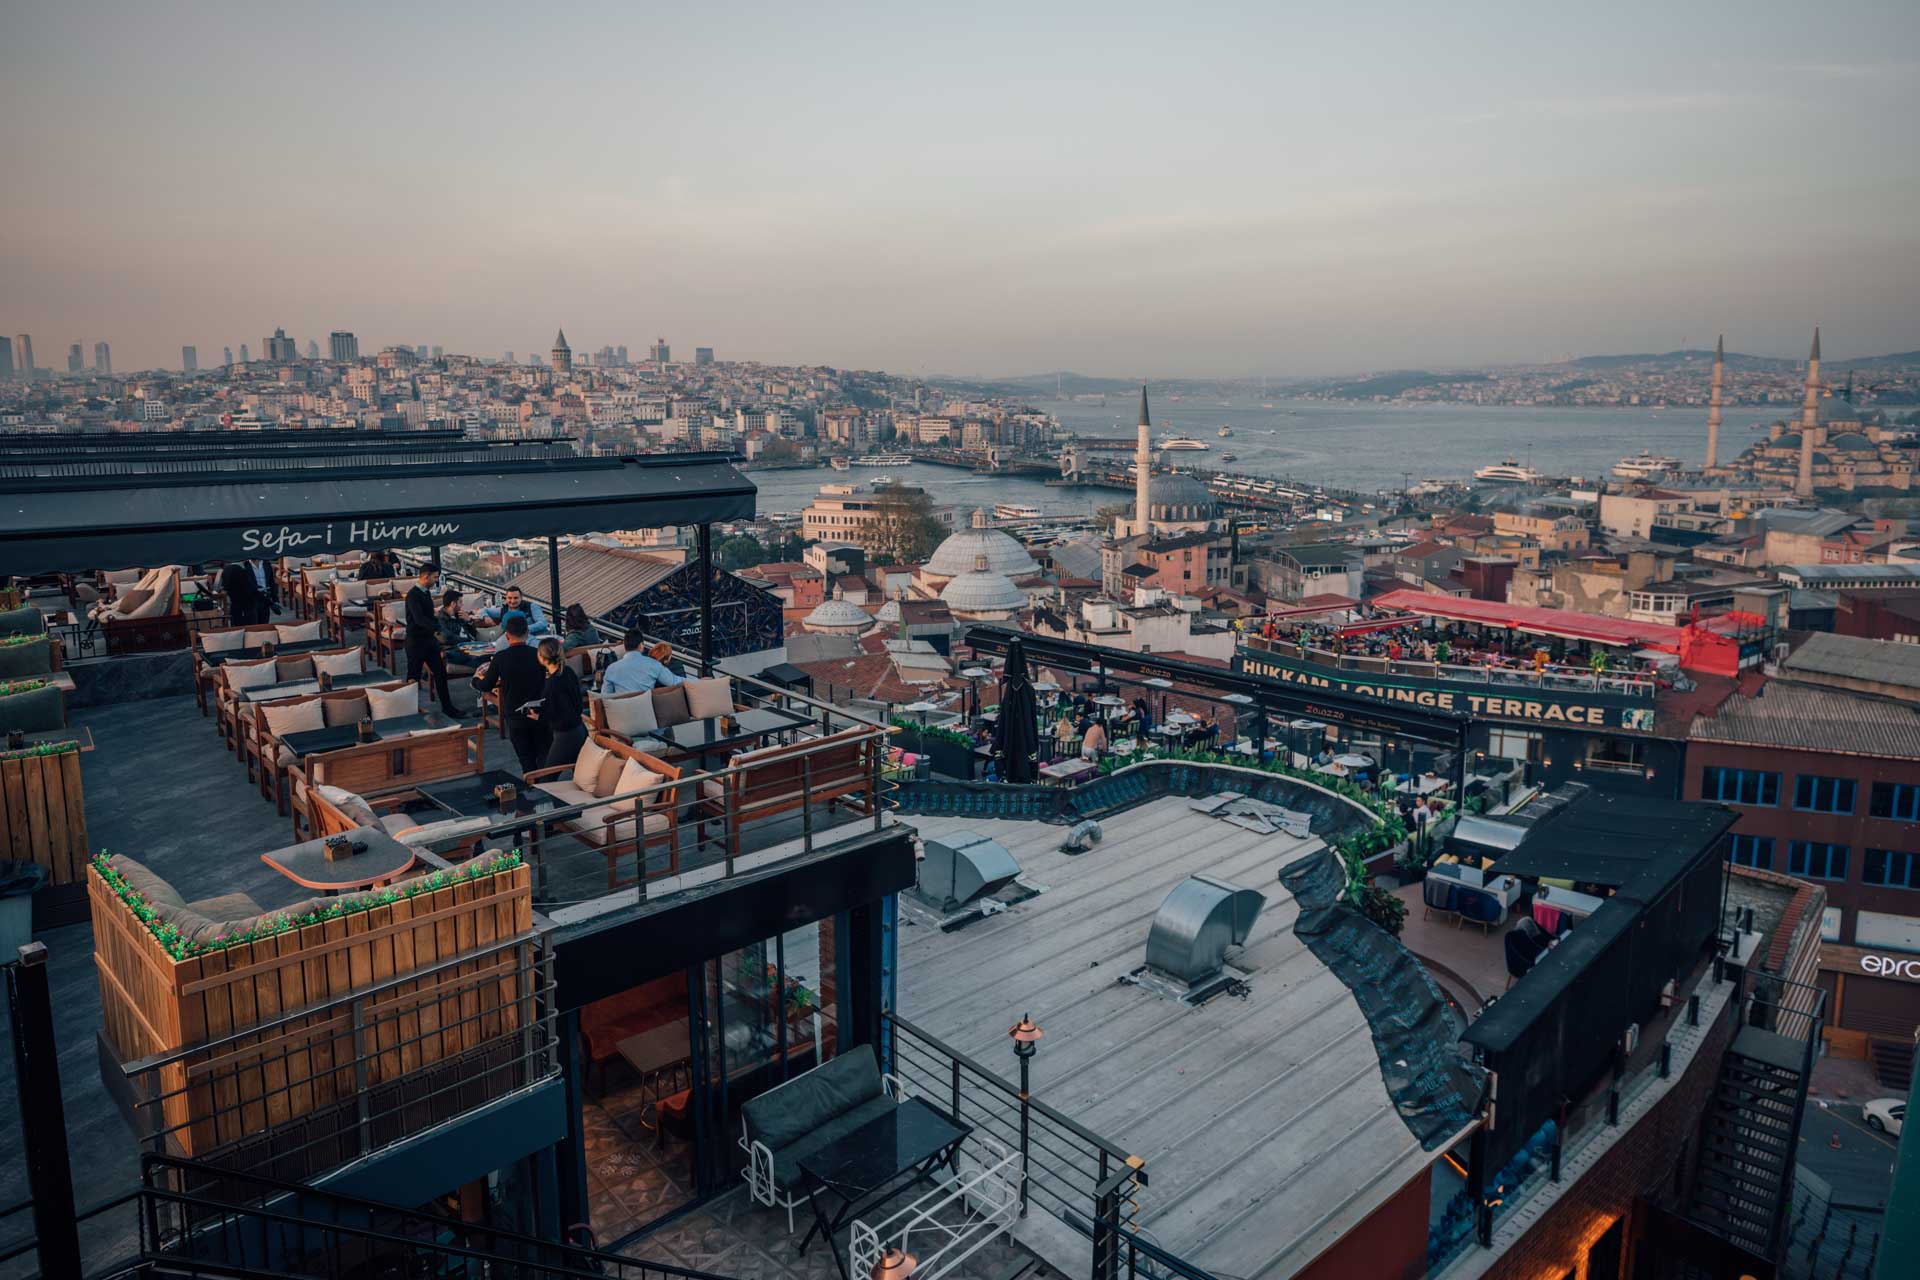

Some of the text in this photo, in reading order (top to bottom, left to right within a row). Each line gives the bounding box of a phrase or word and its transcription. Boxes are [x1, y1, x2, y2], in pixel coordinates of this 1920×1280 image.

[242, 520, 459, 554] Sefa-i Hürrem
[1467, 696, 1605, 724] TERRACE
